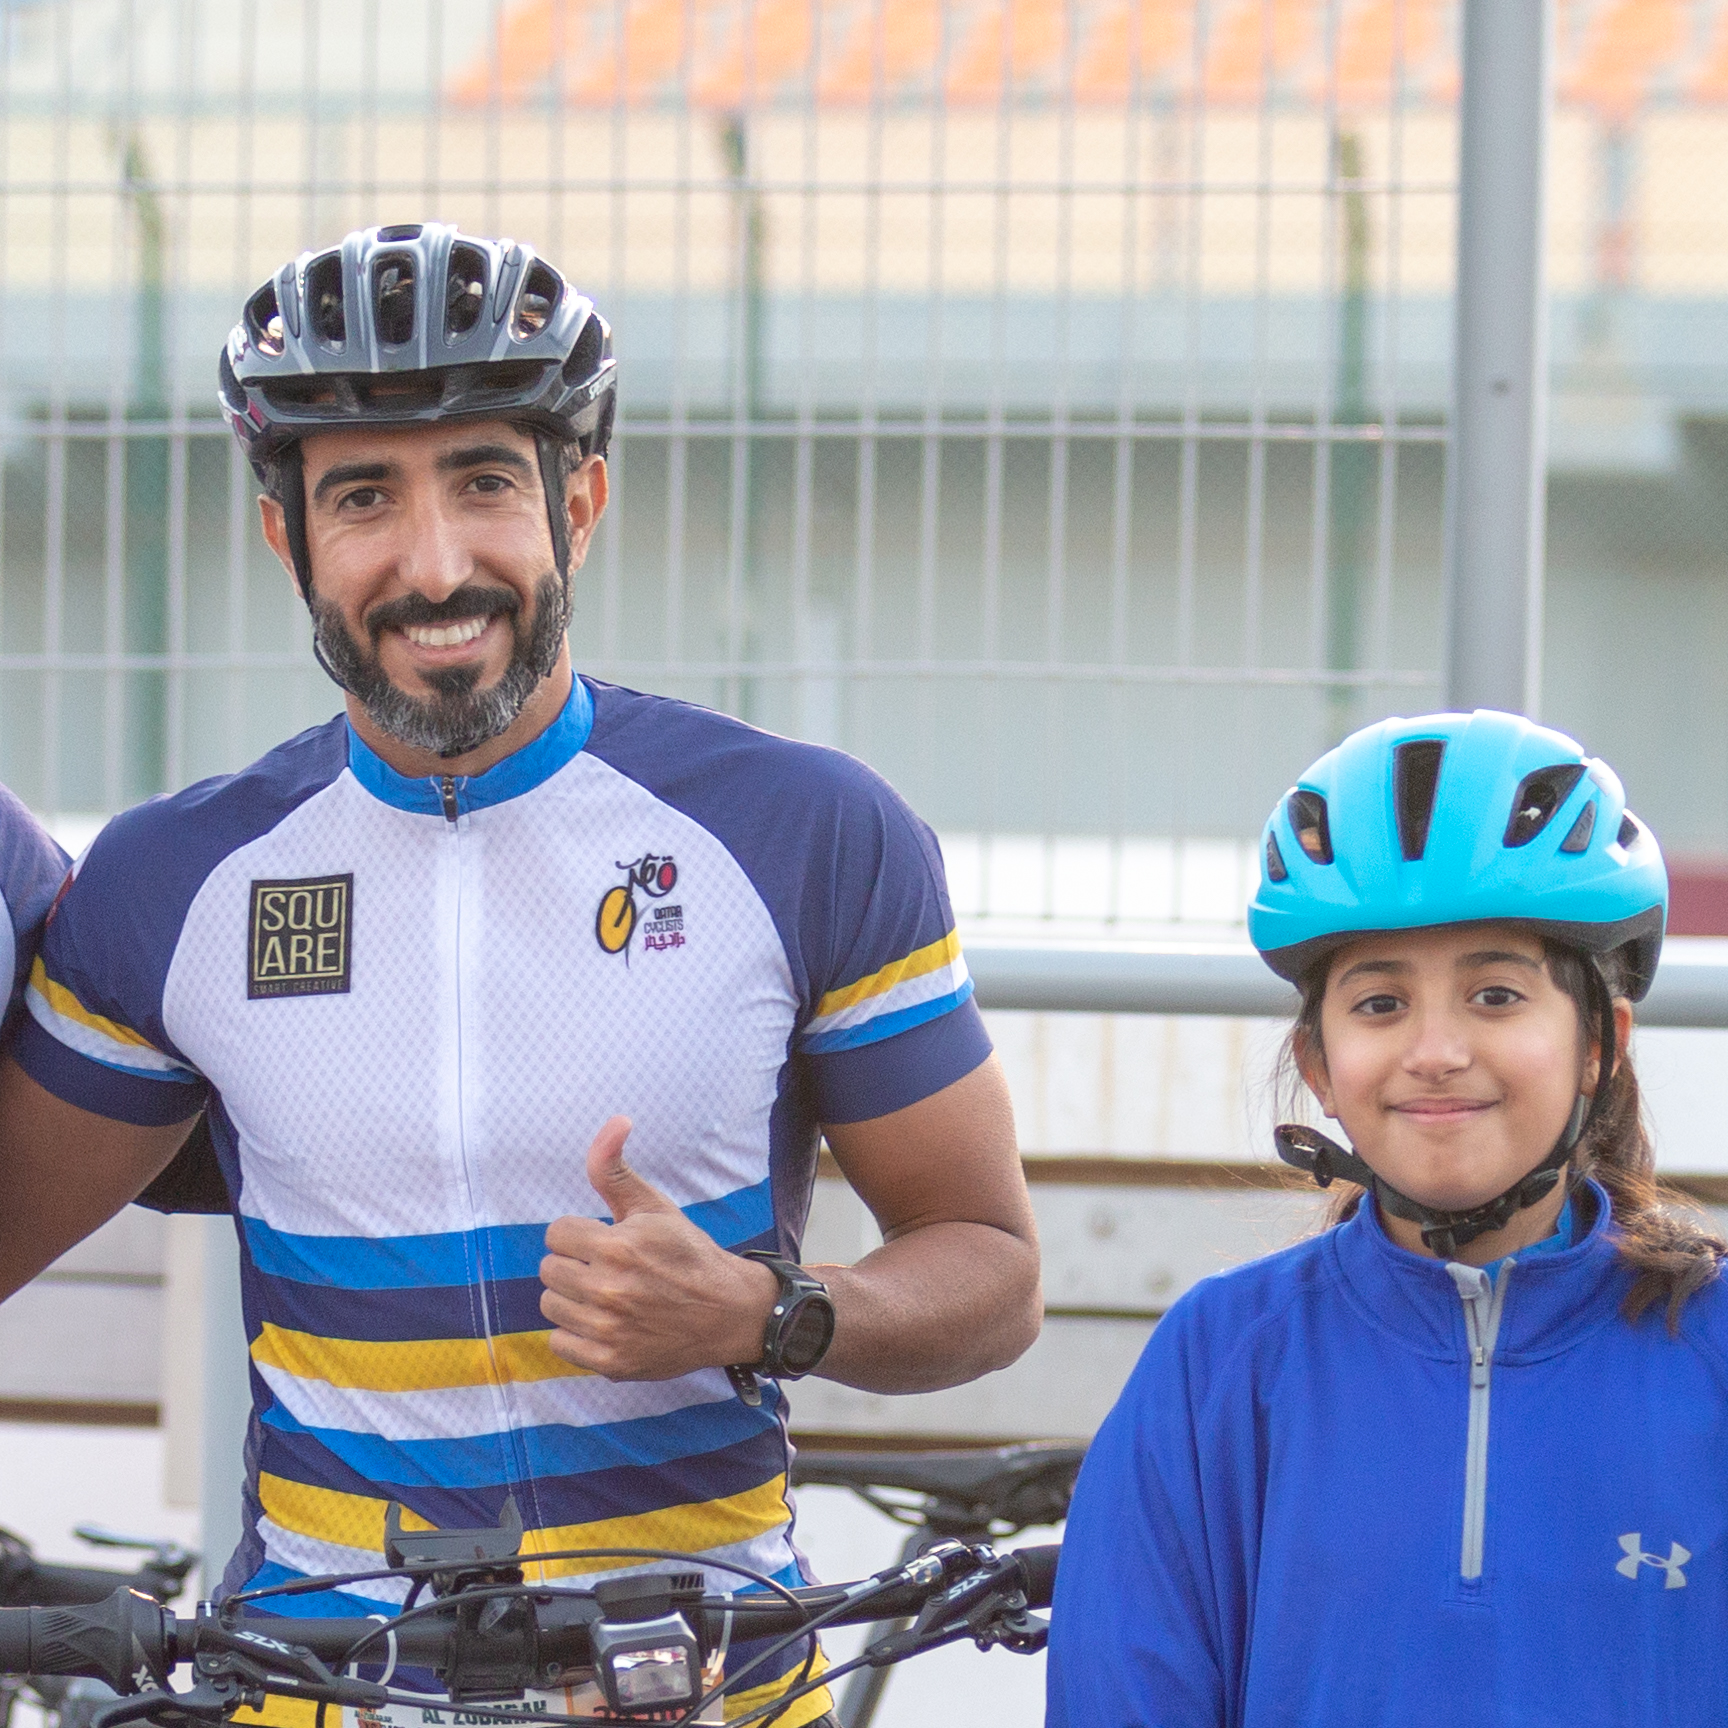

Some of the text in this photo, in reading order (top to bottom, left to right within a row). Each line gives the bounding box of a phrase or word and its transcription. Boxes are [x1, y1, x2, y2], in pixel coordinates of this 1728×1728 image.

[261, 888, 340, 931] SQU
[644, 919, 684, 934] CYCLISTS
[260, 932, 339, 975] ARE
[948, 1571, 992, 1600] SLX
[234, 1631, 290, 1655] SLX
